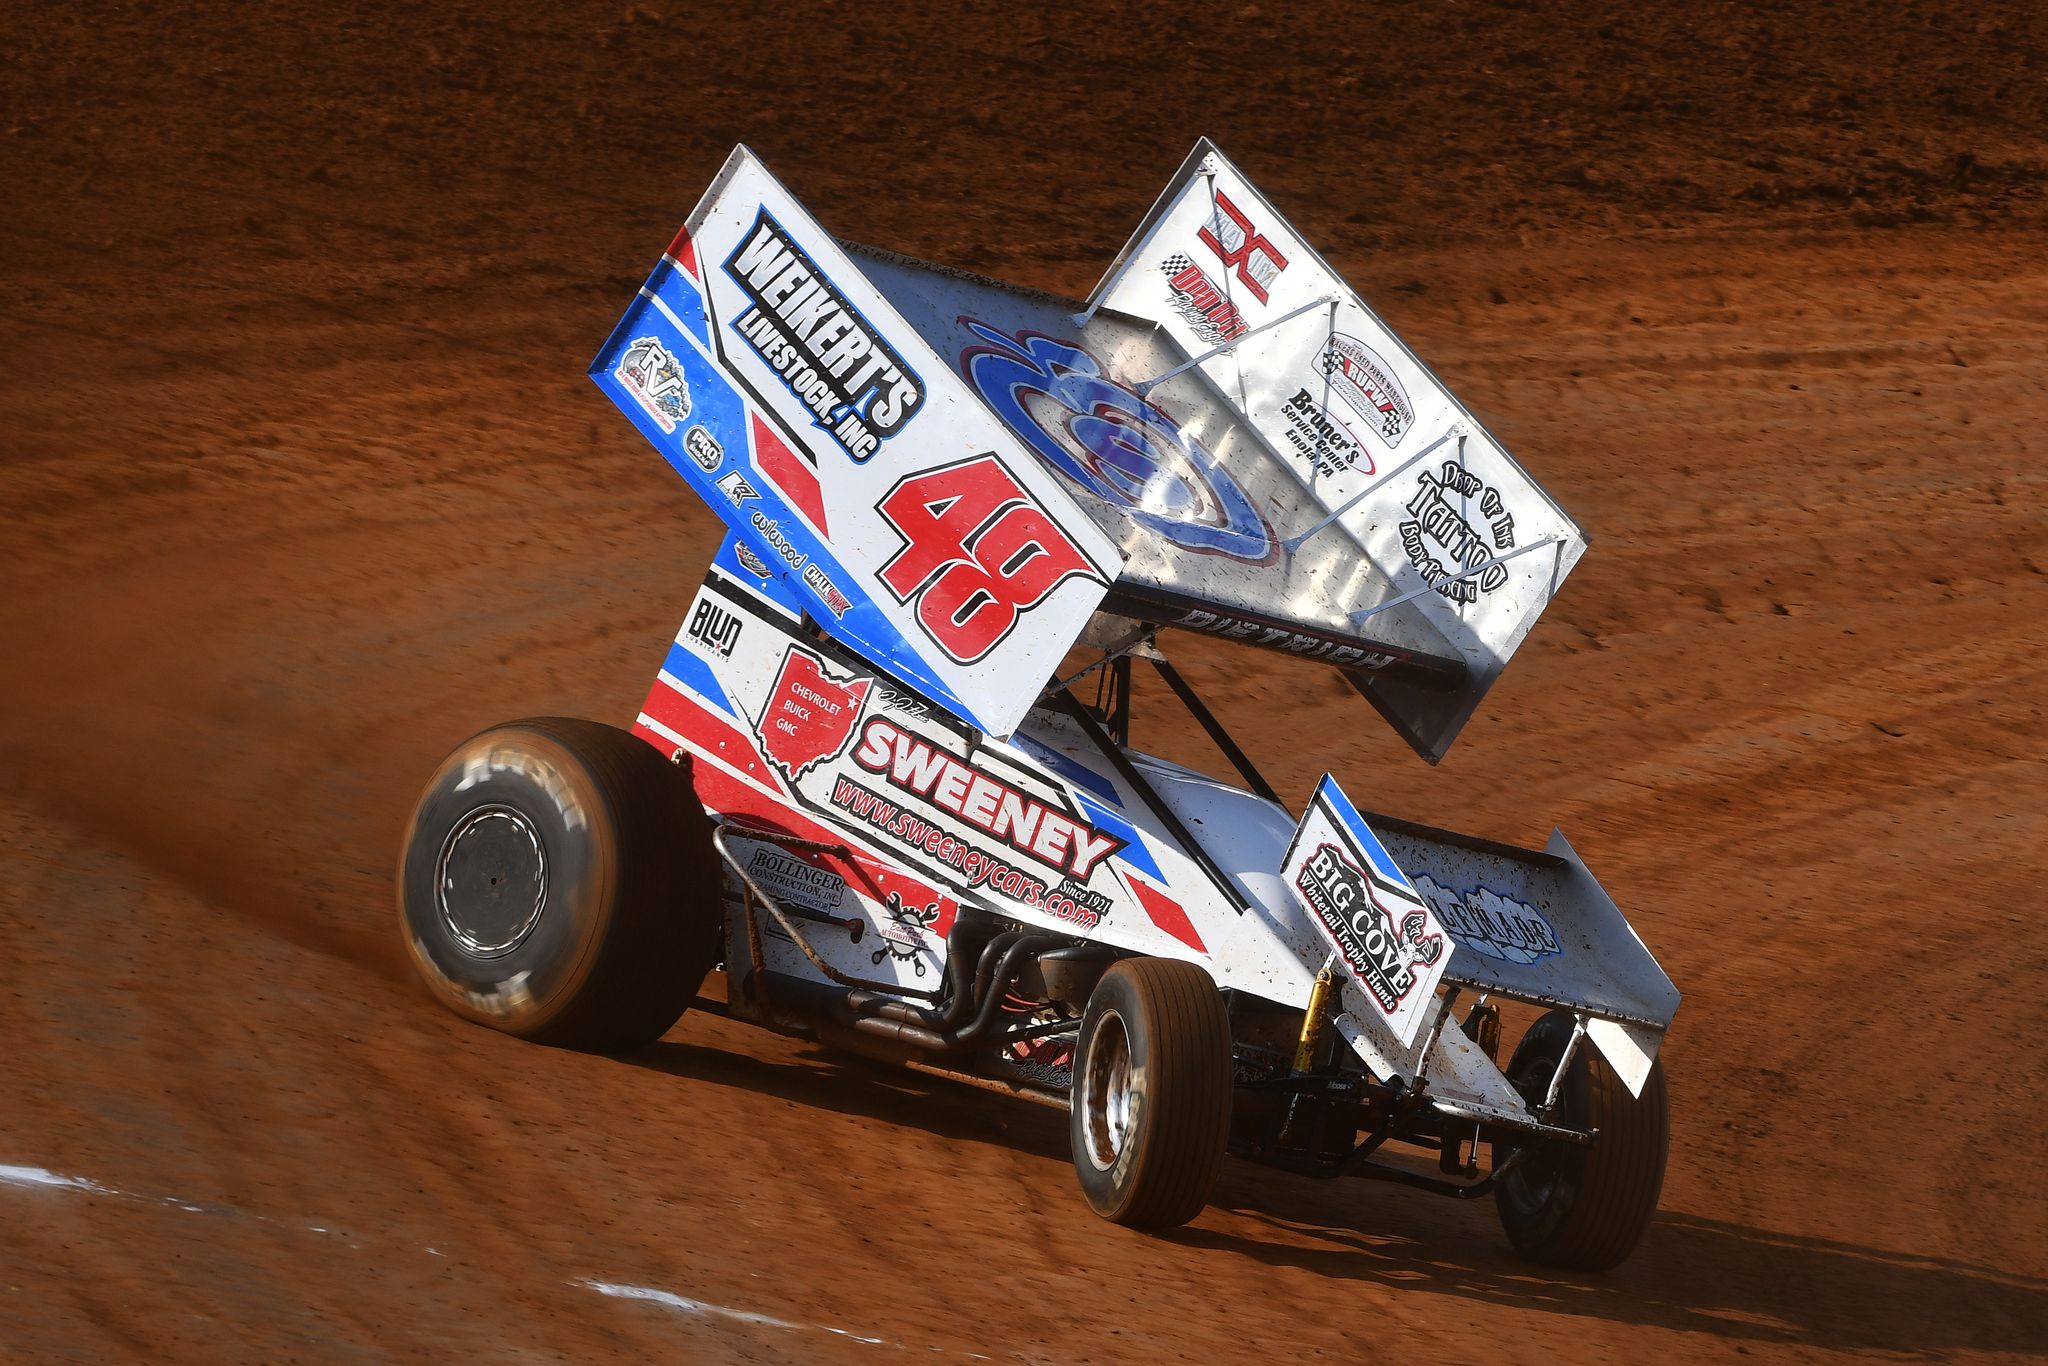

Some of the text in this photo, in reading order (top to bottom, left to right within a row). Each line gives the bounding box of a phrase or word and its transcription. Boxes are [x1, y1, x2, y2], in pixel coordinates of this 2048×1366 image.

[734, 223, 918, 428] WEIKERT'S
[736, 307, 878, 459] LIVESTOCK, INC
[1347, 366, 1388, 408] RUPW
[1355, 351, 1370, 369] USED
[1368, 364, 1386, 384] PARTS
[1385, 380, 1412, 424] WAREHOUSE
[691, 430, 719, 461] PRO
[1281, 403, 1318, 442] Service
[1288, 387, 1360, 464] Bruner's
[1284, 428, 1335, 478] Enola, PA
[1406, 470, 1508, 592] TATTOO
[1443, 461, 1515, 549] DROP OF INK
[752, 512, 807, 568] wilwood
[873, 451, 1112, 667] 48
[1400, 520, 1429, 567] BODY
[1173, 609, 1396, 669] DIETRICH
[776, 718, 798, 737] GMC
[783, 699, 812, 721] BUICK
[791, 682, 842, 716] CHEVROLET
[856, 720, 1118, 879] SWEENEY
[750, 867, 822, 899] CONSTRUCTION,
[755, 852, 844, 891] BOLLINGER
[835, 778, 1099, 932] www.sweeneycars.com
[1060, 880, 1112, 913] Since 1921
[1309, 848, 1415, 995] BIG COVE
[1299, 872, 1396, 1010] Whitetail Trophy Hunts
